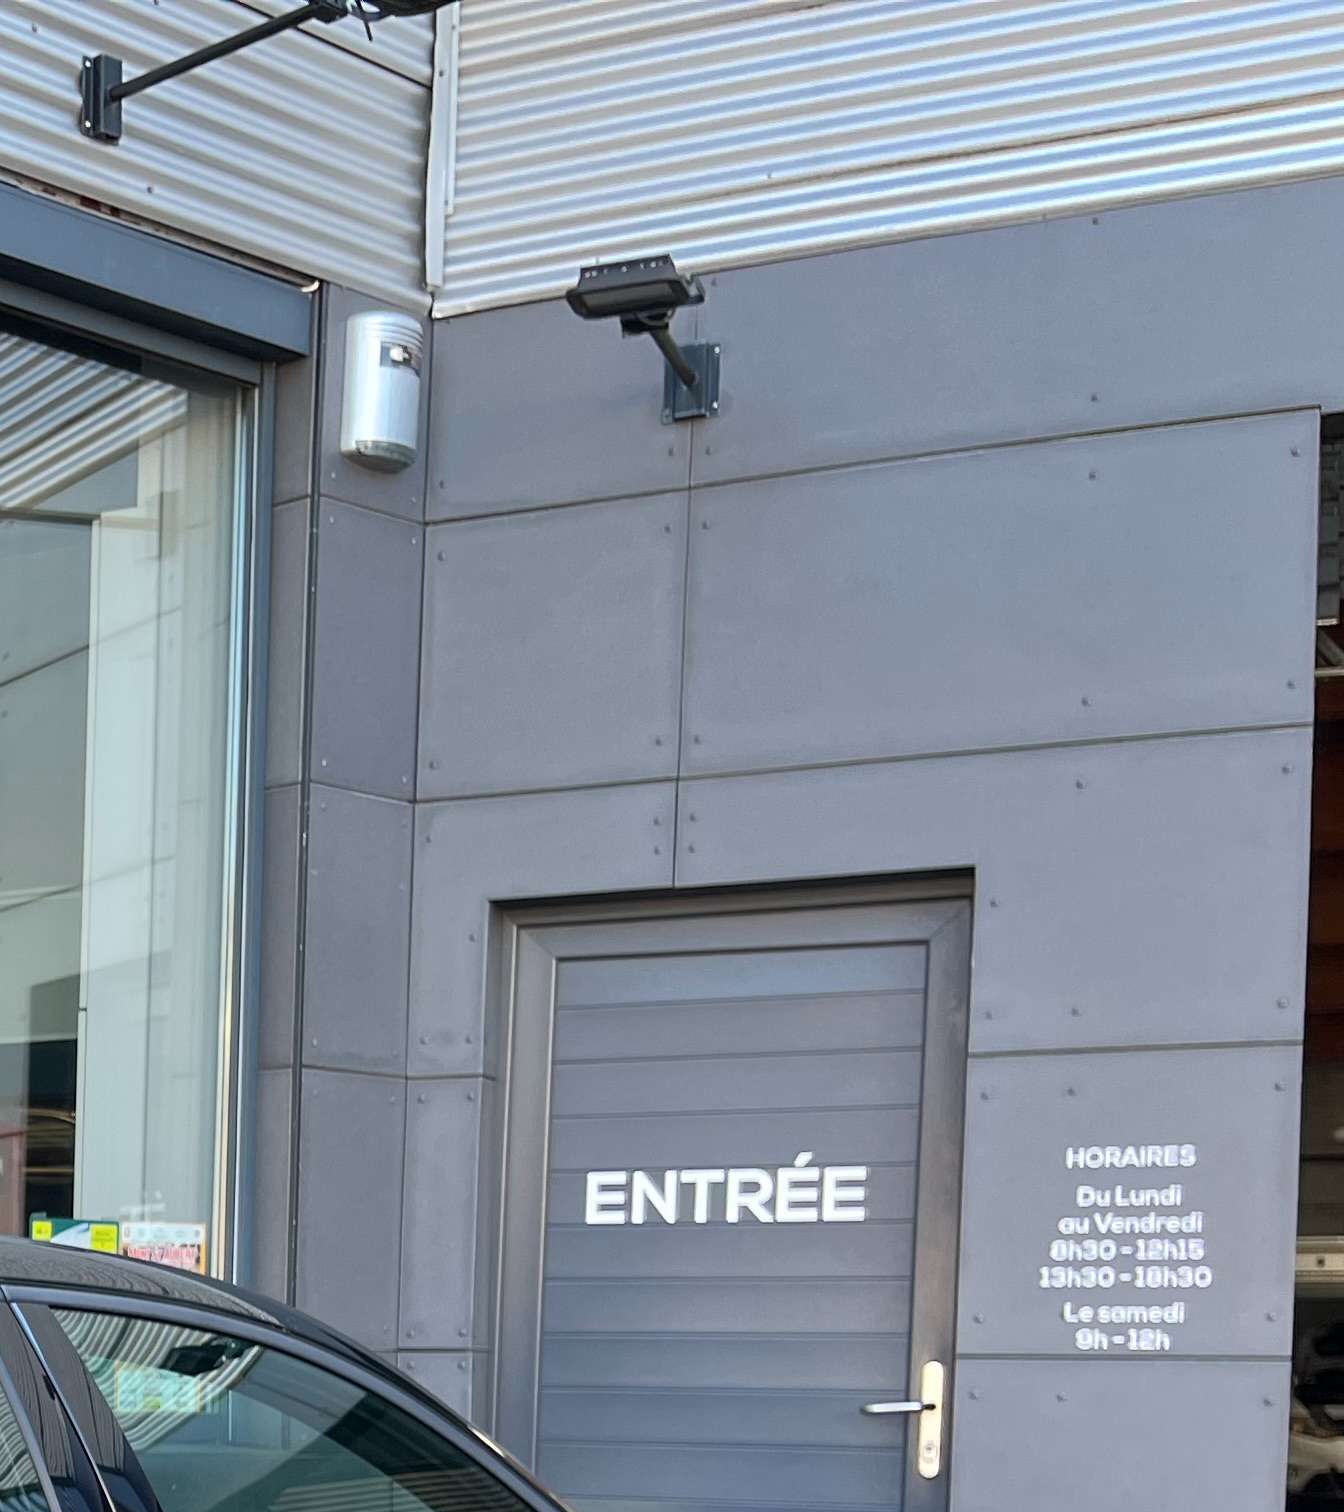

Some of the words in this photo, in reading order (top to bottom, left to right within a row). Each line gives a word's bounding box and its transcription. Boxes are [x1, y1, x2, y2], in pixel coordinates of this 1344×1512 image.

[1065, 1144, 1197, 1169] HORAIRES
[585, 1151, 867, 1224] ENTRÉE
[1075, 1185, 1111, 1207] Du
[1114, 1184, 1183, 1207] Lundi
[1057, 1216, 1090, 1234] au
[1093, 1211, 1204, 1234] Vendredi
[1063, 1301, 1094, 1323] Le
[1096, 1301, 1185, 1324] samedi
